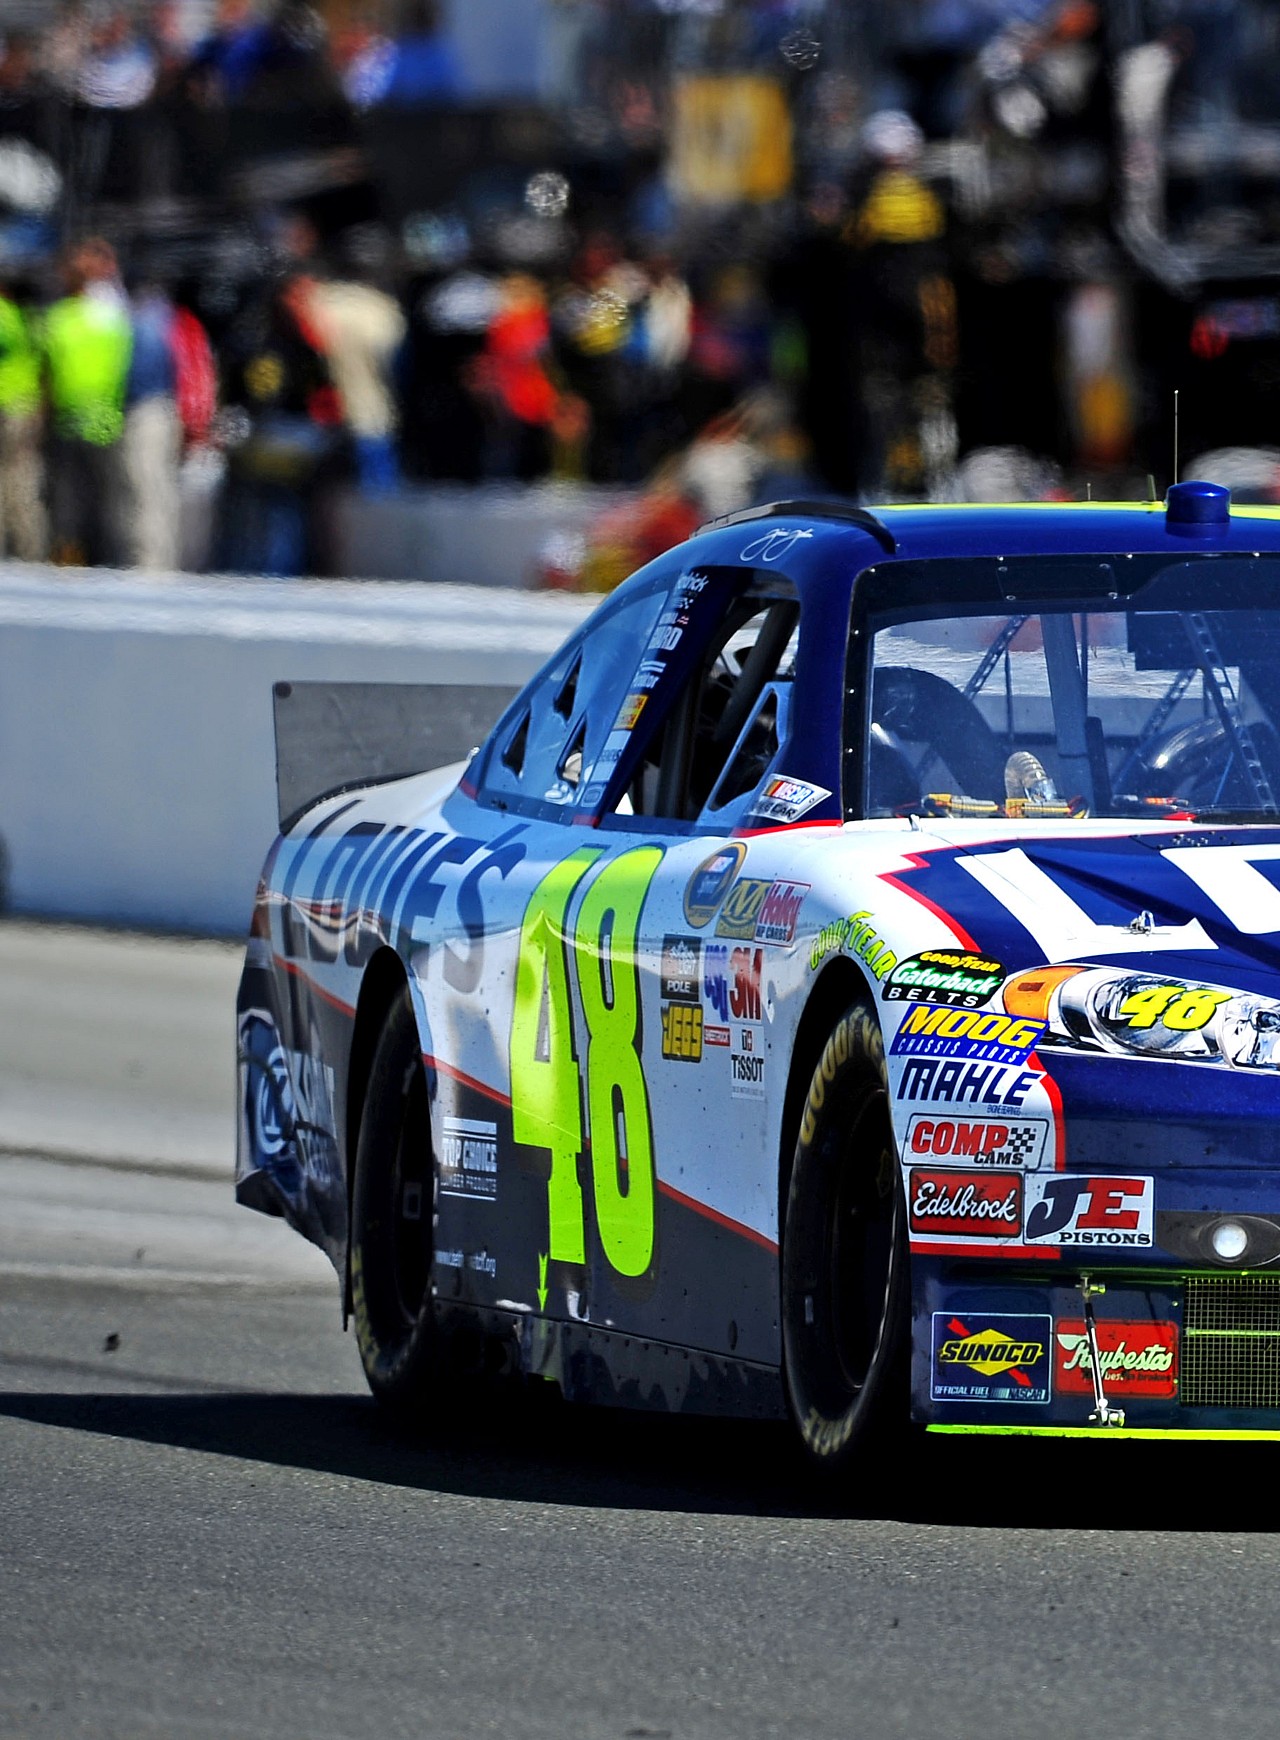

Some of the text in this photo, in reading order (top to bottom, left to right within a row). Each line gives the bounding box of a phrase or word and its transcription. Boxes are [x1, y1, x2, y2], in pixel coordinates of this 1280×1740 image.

[891, 960, 1000, 995] Gatorback
[918, 951, 1001, 973] GOODYEAR
[666, 979, 691, 994] POLE
[887, 987, 979, 1007] BELTS
[1119, 985, 1233, 1031] 48
[900, 1006, 1046, 1049] MOOG
[510, 845, 668, 1278] 48
[897, 1037, 1021, 1063] CHASSIS PARTS
[897, 1058, 1042, 1107] MAHLE
[911, 1121, 1010, 1156] COMP
[973, 1151, 1024, 1165] CAMS
[913, 1182, 1018, 1221] Edelbrock
[1026, 1177, 1146, 1240] JE
[1059, 1232, 1151, 1244] PISTONS
[942, 1342, 1040, 1363] SUNOCO
[1056, 1334, 1174, 1378] Rybestos
[934, 1386, 967, 1396] OFFICIAL
[969, 1386, 989, 1396] FUEL
